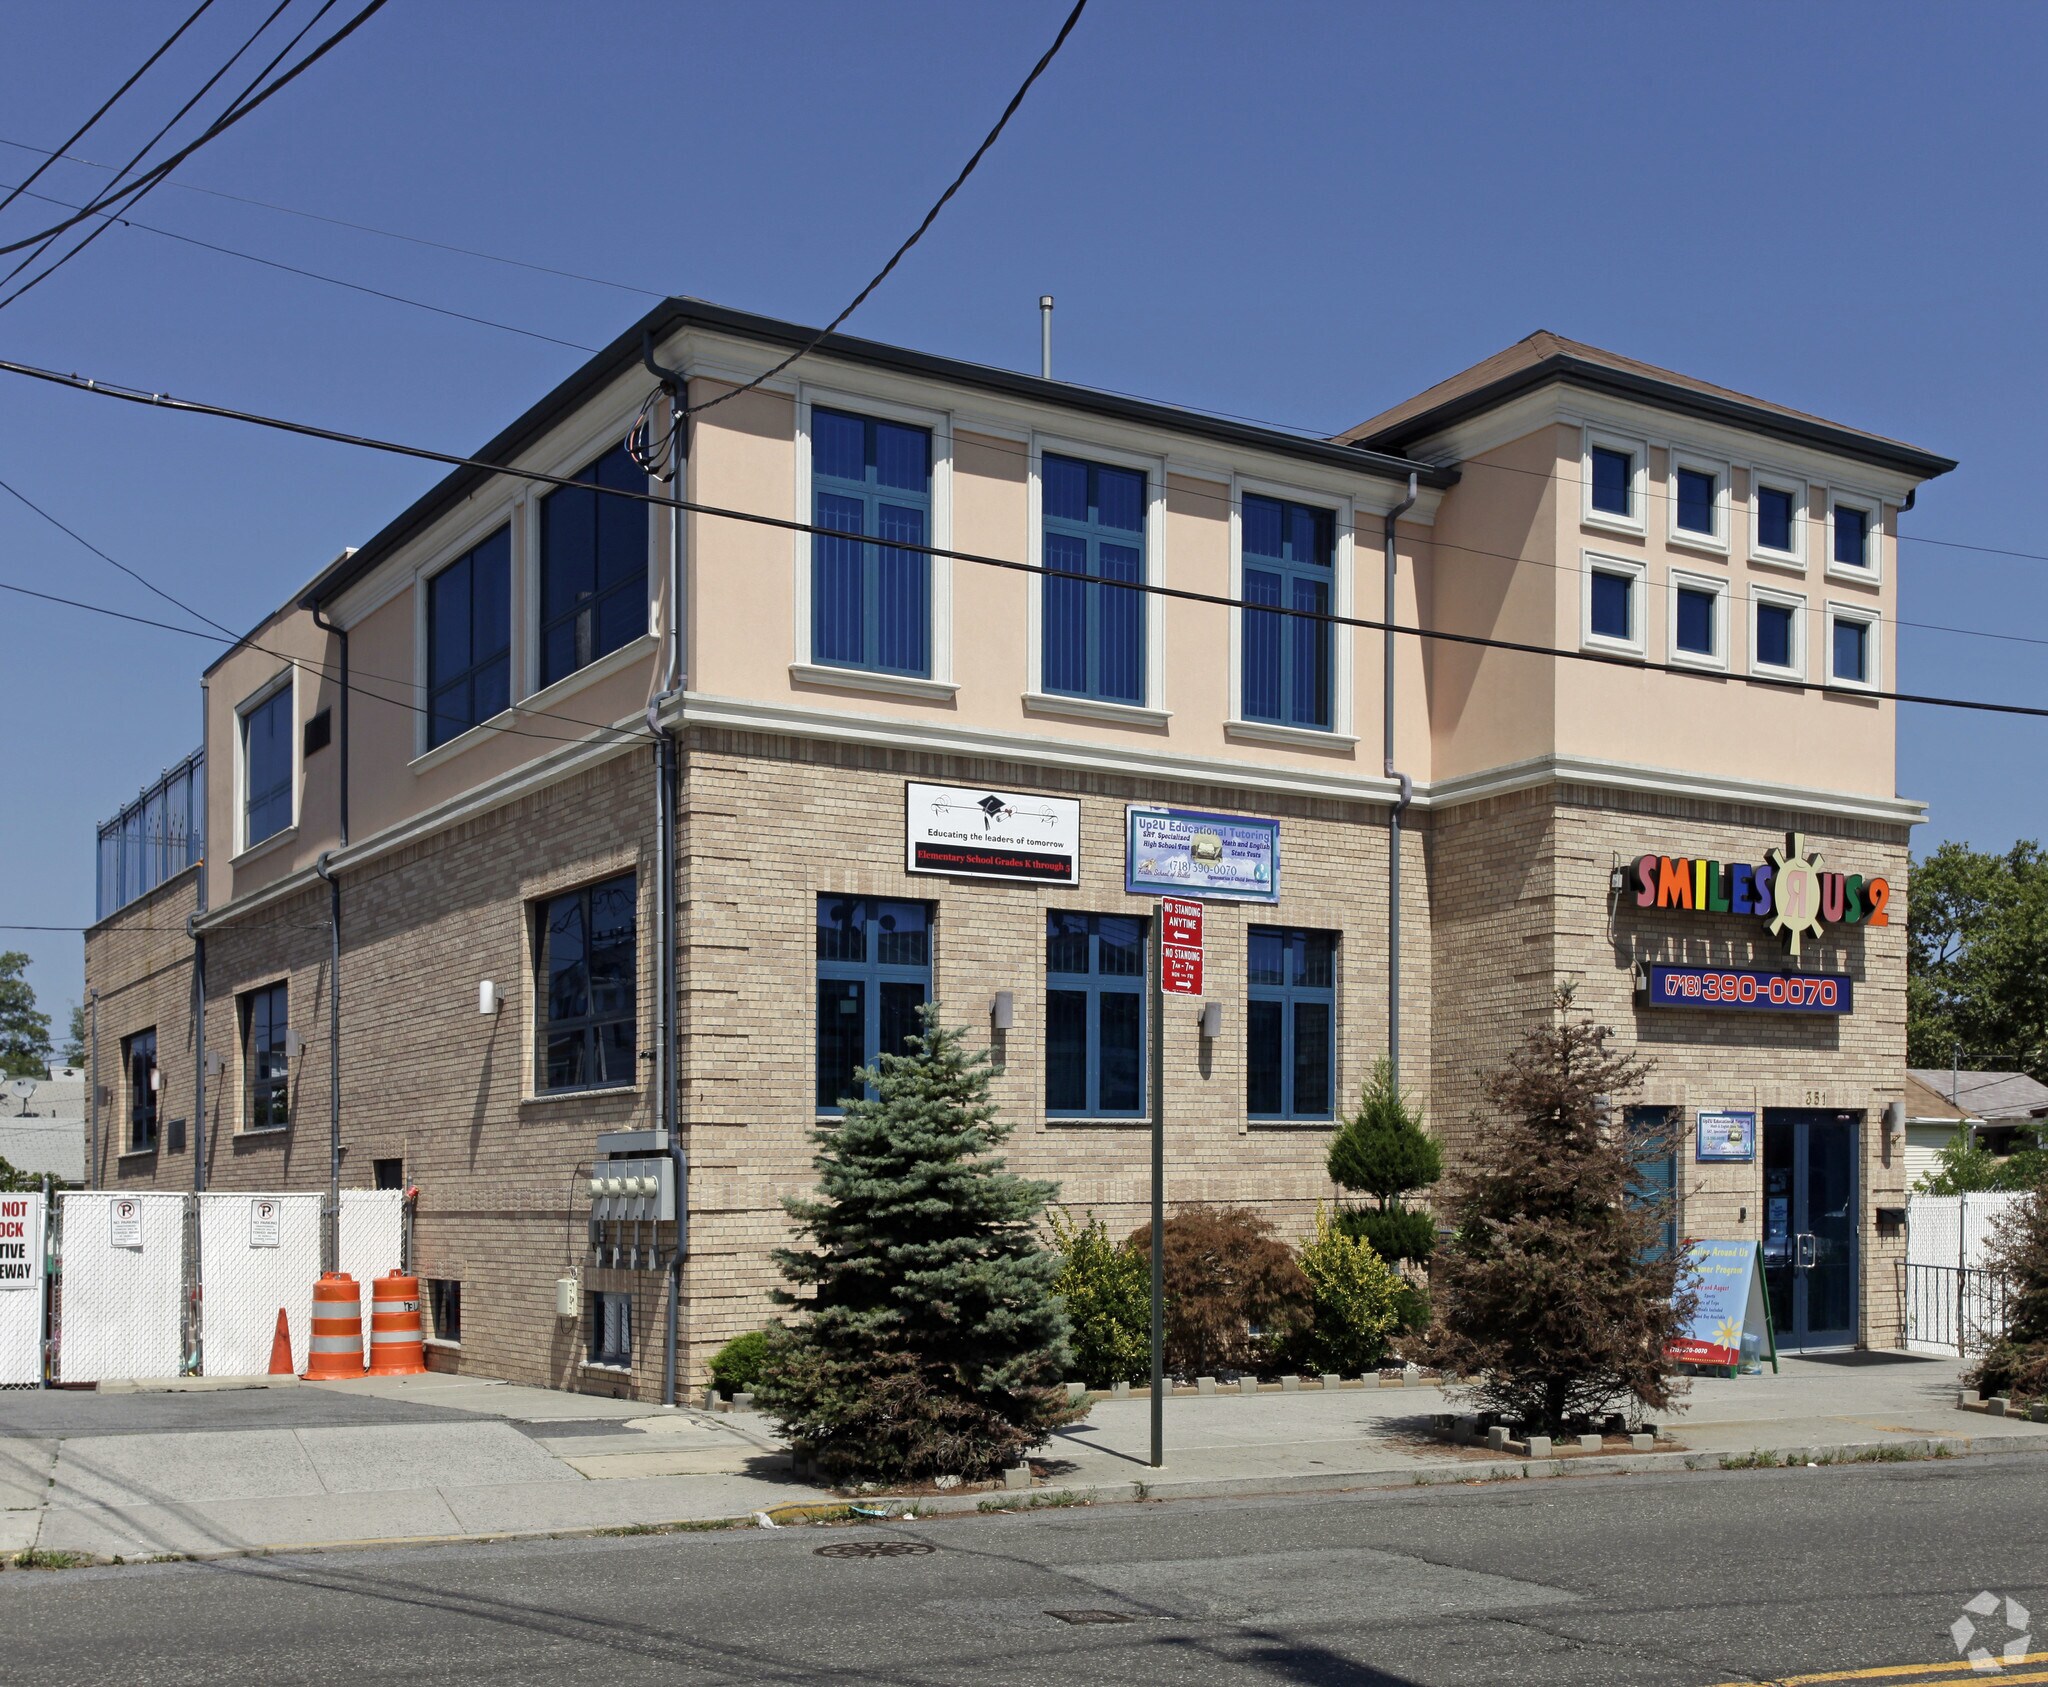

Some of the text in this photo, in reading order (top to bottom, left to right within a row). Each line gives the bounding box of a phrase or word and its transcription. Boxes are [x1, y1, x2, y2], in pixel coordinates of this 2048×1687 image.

[927, 828, 968, 841] Educating
[985, 834, 1014, 844] leaders
[1016, 837, 1025, 845] of
[1026, 839, 1064, 848] tomorrow
[1139, 818, 1270, 843] Up2U Educational Tutoring
[1158, 833, 1191, 842] Specialized
[1143, 840, 1190, 851] High School Test
[1250, 842, 1270, 850] English
[917, 850, 965, 864] Elementary
[966, 854, 993, 865] School
[994, 857, 1024, 867] Grades
[1025, 860, 1032, 868] K
[1033, 860, 1064, 872] through
[1193, 862, 1237, 876] 390-0070
[1637, 854, 1772, 916] SMILES
[1823, 872, 1862, 924] US
[1868, 877, 1889, 927] 2
[1164, 902, 1201, 917] NO STANDING
[1168, 917, 1197, 929] ANYTIME
[1165, 947, 1200, 962] NO STANDING
[1171, 960, 1181, 970] 7AM
[1185, 962, 1194, 971] 7PM
[1702, 973, 1838, 1006] 390-0070
[1805, 1091, 1826, 1106] 351
[2, 1201, 28, 1217] NOT
[1713, 1247, 1737, 1257] Around
[1739, 1248, 1749, 1257] Us
[1715, 1265, 1743, 1276] Program
